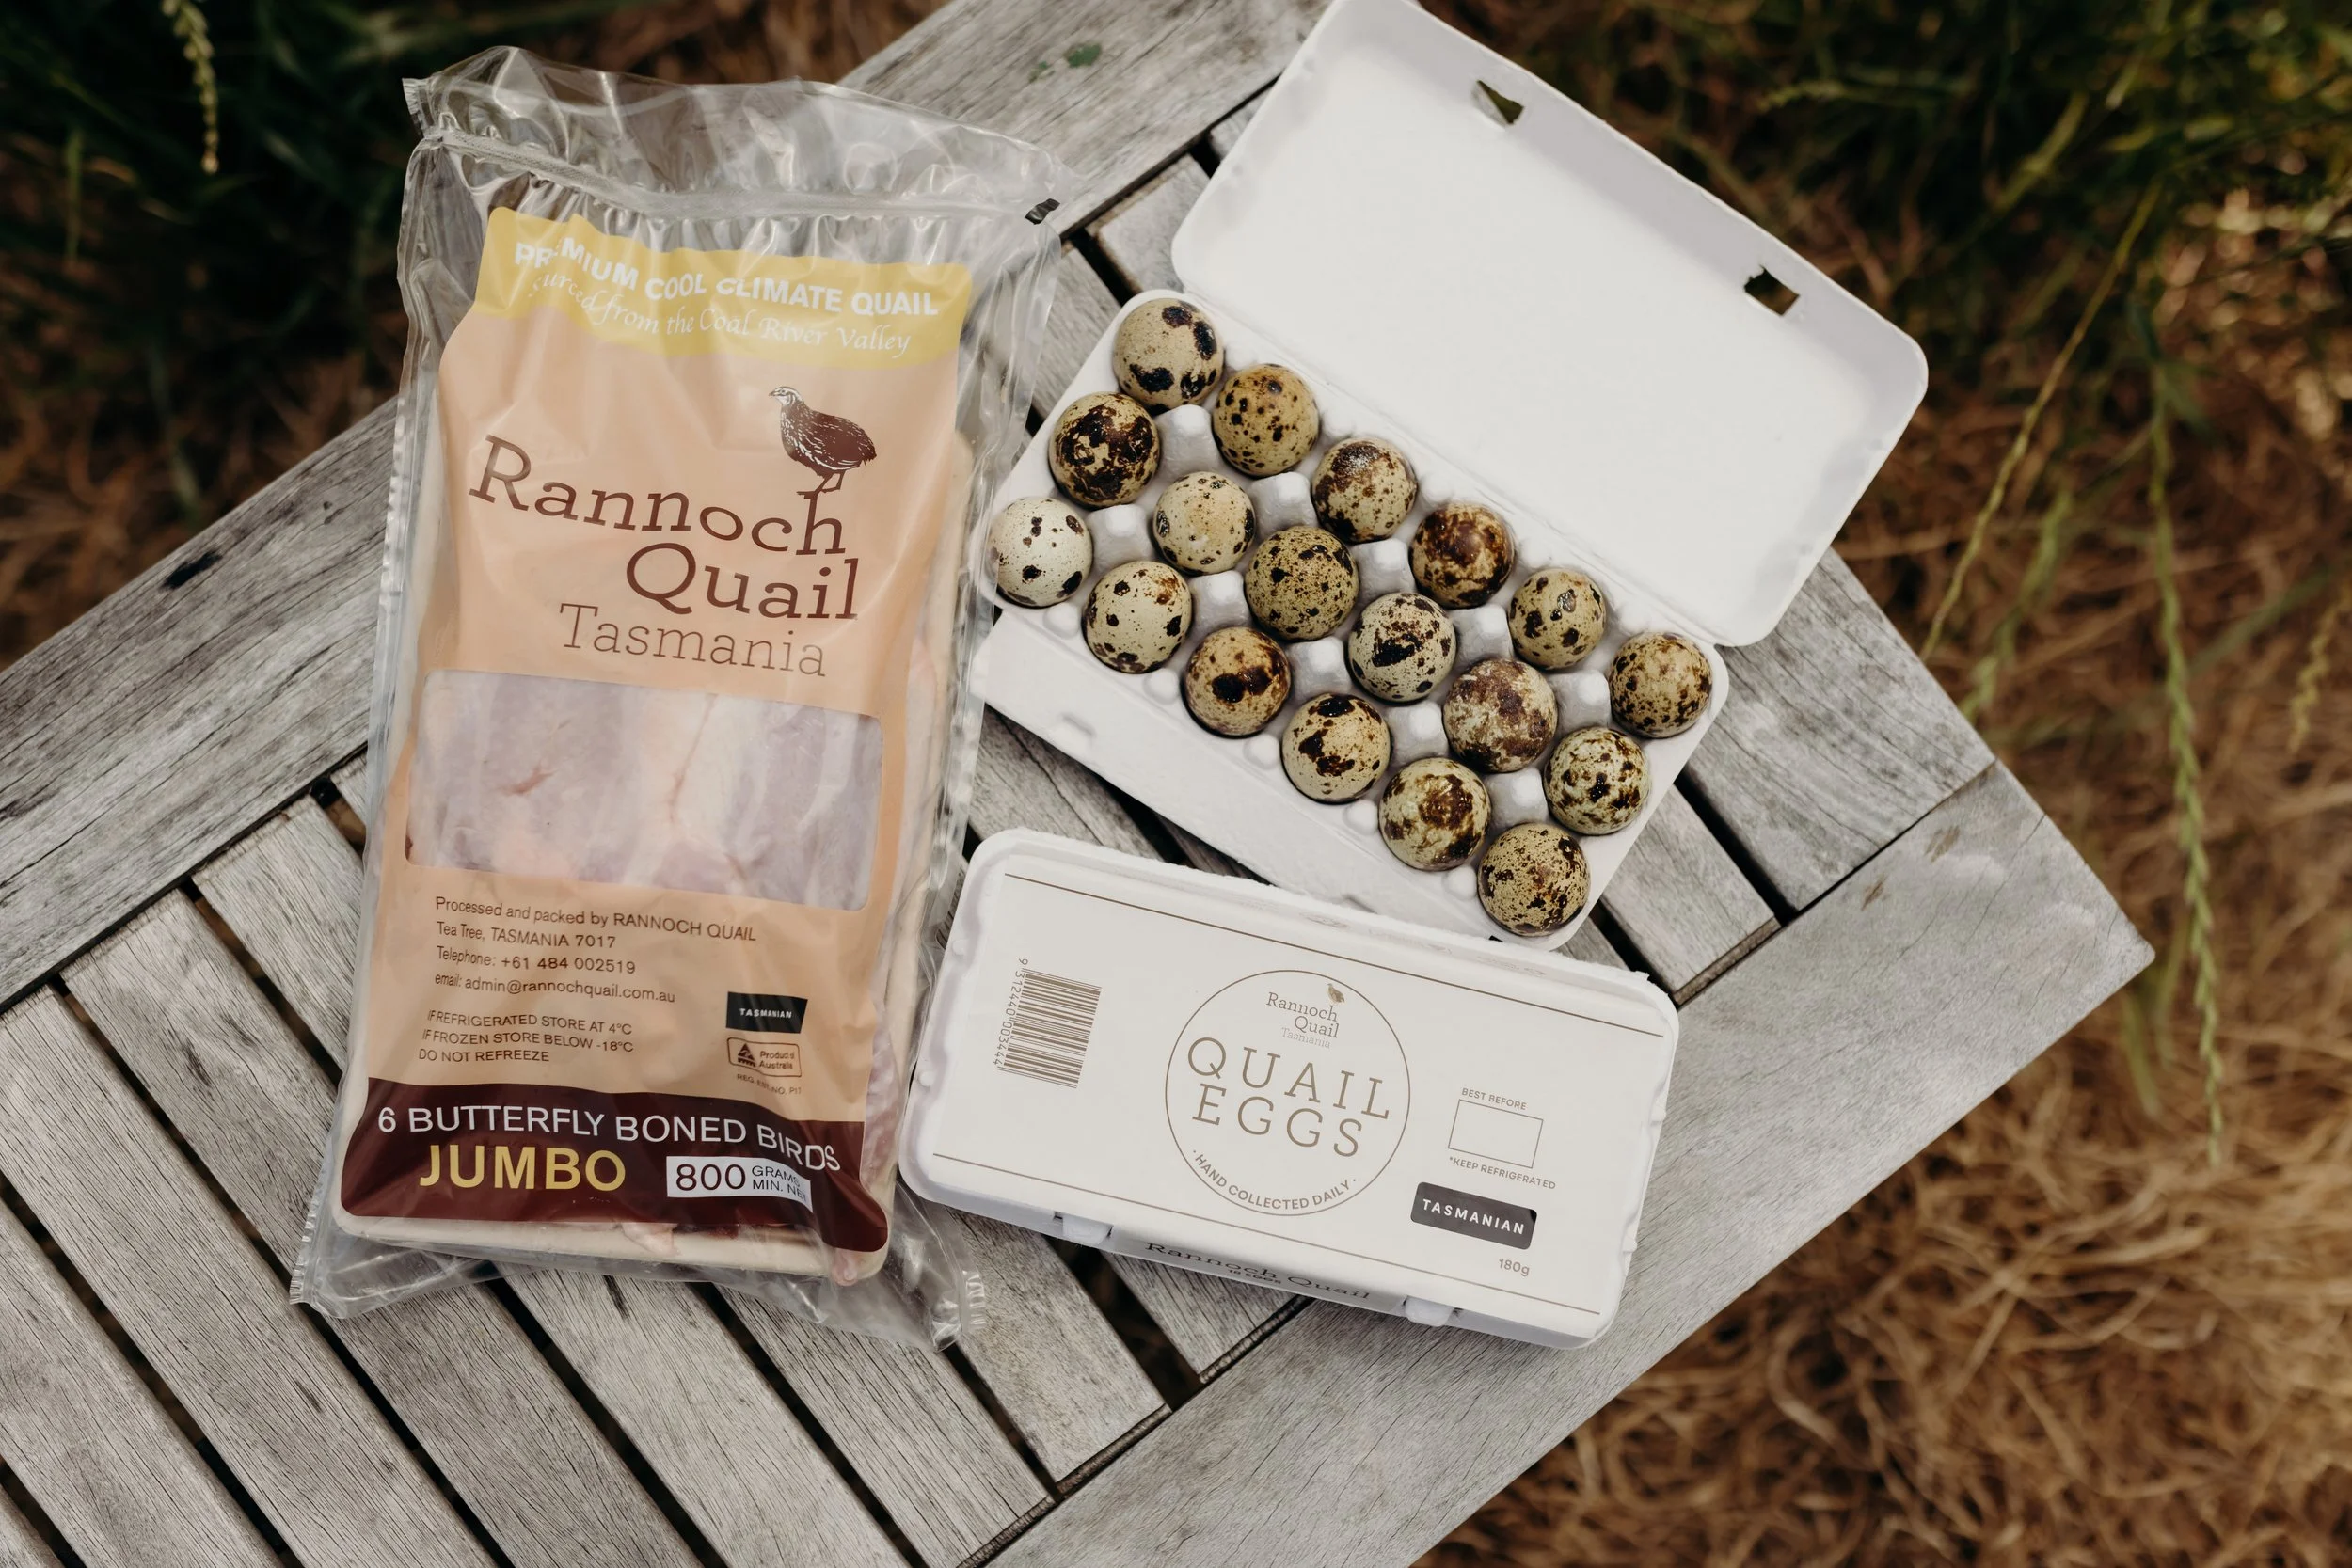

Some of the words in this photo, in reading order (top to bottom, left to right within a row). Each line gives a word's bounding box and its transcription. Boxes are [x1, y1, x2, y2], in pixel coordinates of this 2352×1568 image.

[644, 273, 707, 300] COOL
[716, 277, 843, 312] CLIMATE
[851, 291, 938, 316] QUAIL
[591, 293, 659, 334] from
[666, 306, 694, 335] the
[699, 308, 756, 336] Coal
[759, 316, 828, 345] River
[835, 325, 912, 358] Valley
[469, 434, 846, 556] Rannoch
[626, 543, 859, 621] Quail
[559, 603, 826, 677] Tasmania
[436, 896, 503, 916] Processed
[506, 906, 531, 920] and
[534, 910, 585, 925] packed
[591, 911, 609, 928] by
[613, 913, 702, 936] RANNOCH
[707, 923, 756, 941] QUAIL
[437, 921, 457, 937] Tea
[461, 923, 485, 941] Tree,
[491, 927, 569, 947] TASMANIA
[575, 934, 616, 948] 7017
[437, 945, 496, 966] Telephone:
[501, 956, 530, 970] +61
[537, 958, 569, 970] 484
[574, 958, 635, 974] 002519
[435, 974, 462, 987] email:
[465, 976, 675, 1003] admin@rannochquail.com.au
[739, 1007, 792, 1018] TASMANIAN
[1266, 992, 1337, 1022] Rannoch
[427, 1009, 436, 1021] IF
[436, 1011, 537, 1027] REFRIGERATED
[541, 1016, 586, 1031] STORE
[589, 1022, 605, 1033] AT
[609, 1023, 632, 1035] 4°C
[1295, 1016, 1340, 1038] Quail
[422, 1029, 432, 1040] IF
[433, 1030, 488, 1044] FROZEN
[493, 1032, 540, 1043] STORE
[544, 1034, 593, 1049] BELOW
[596, 1041, 634, 1052] -18°C
[1281, 1027, 1331, 1049] Tasmania
[419, 1048, 437, 1061] DO
[441, 1052, 470, 1062] NOT
[475, 1050, 549, 1062] REFREEZE
[1187, 1037, 1390, 1119] QUAIL
[1461, 1087, 1486, 1101] BEST
[1488, 1094, 1528, 1111] BEFORE
[1192, 1083, 1361, 1157] EGGS
[378, 1107, 396, 1132] 6
[408, 1105, 605, 1136] BUTTERFLY
[615, 1115, 746, 1143] BONED
[756, 1124, 841, 1171] BIRDS
[420, 1144, 626, 1191] JUMBO
[675, 1164, 746, 1191] 800
[1195, 1154, 1228, 1187] HAND
[1228, 1184, 1310, 1210] COLLECTED
[1311, 1180, 1350, 1206] DAILY
[1480, 1164, 1556, 1190] REFRIGERATED
[753, 1180, 784, 1193] MIN.
[1422, 1198, 1525, 1235] TASMANIAN
[1145, 1242, 1279, 1279] Rannoch
[1287, 1275, 1371, 1299] Quail
[1499, 1258, 1530, 1277] 180g
